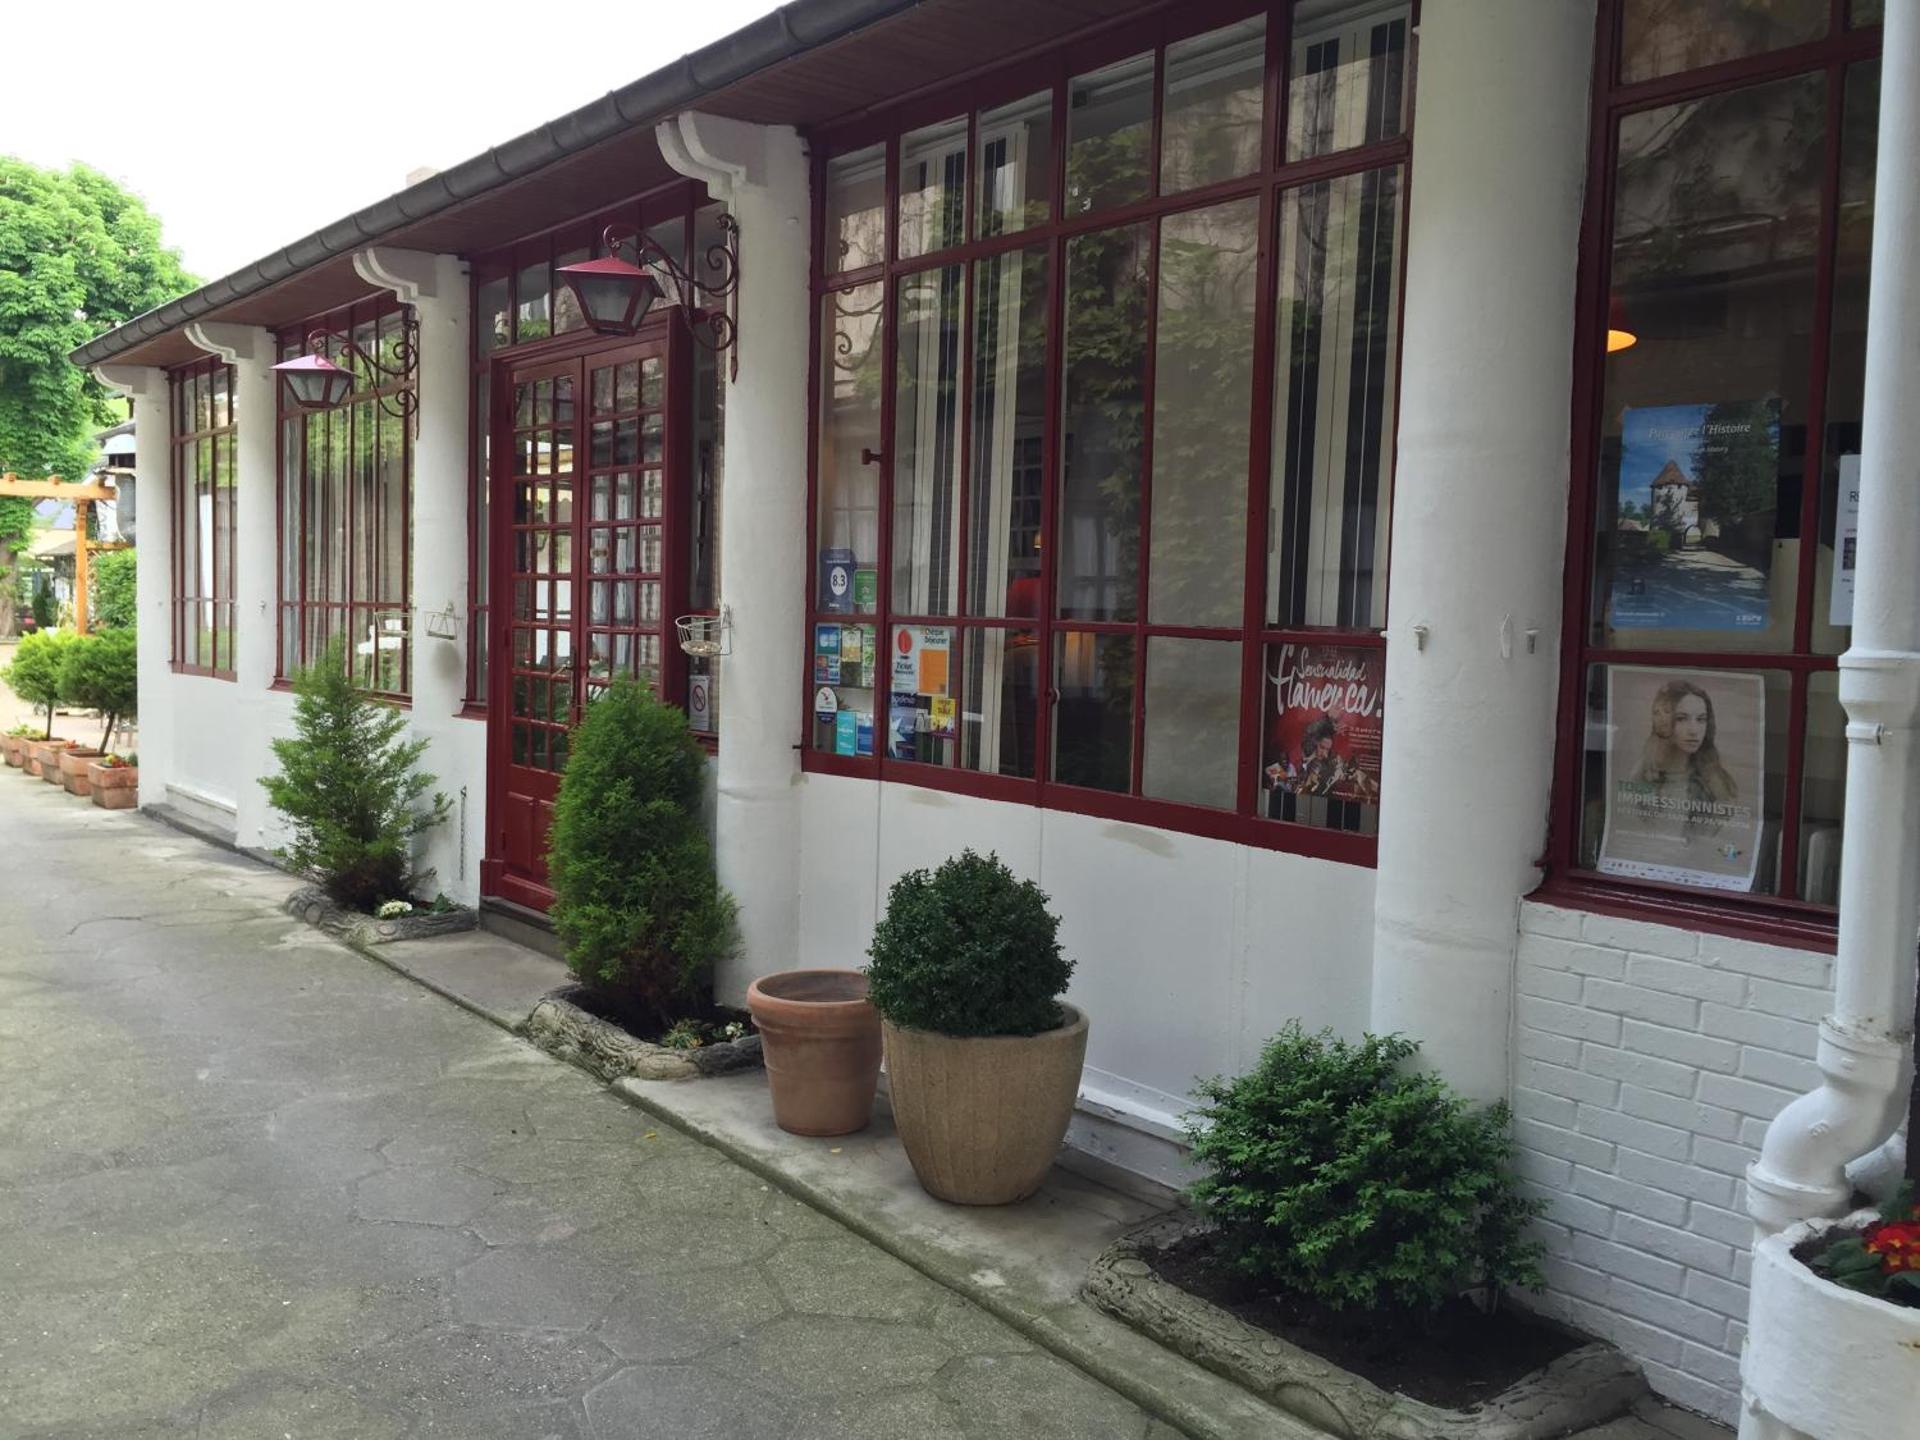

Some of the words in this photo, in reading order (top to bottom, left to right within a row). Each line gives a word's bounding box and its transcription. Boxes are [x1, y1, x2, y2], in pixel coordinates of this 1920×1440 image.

[832, 574, 846, 587] 8.3
[1297, 646, 1366, 681] Sensualidad
[1617, 792, 1751, 818] IMPRESSIONNISTES
